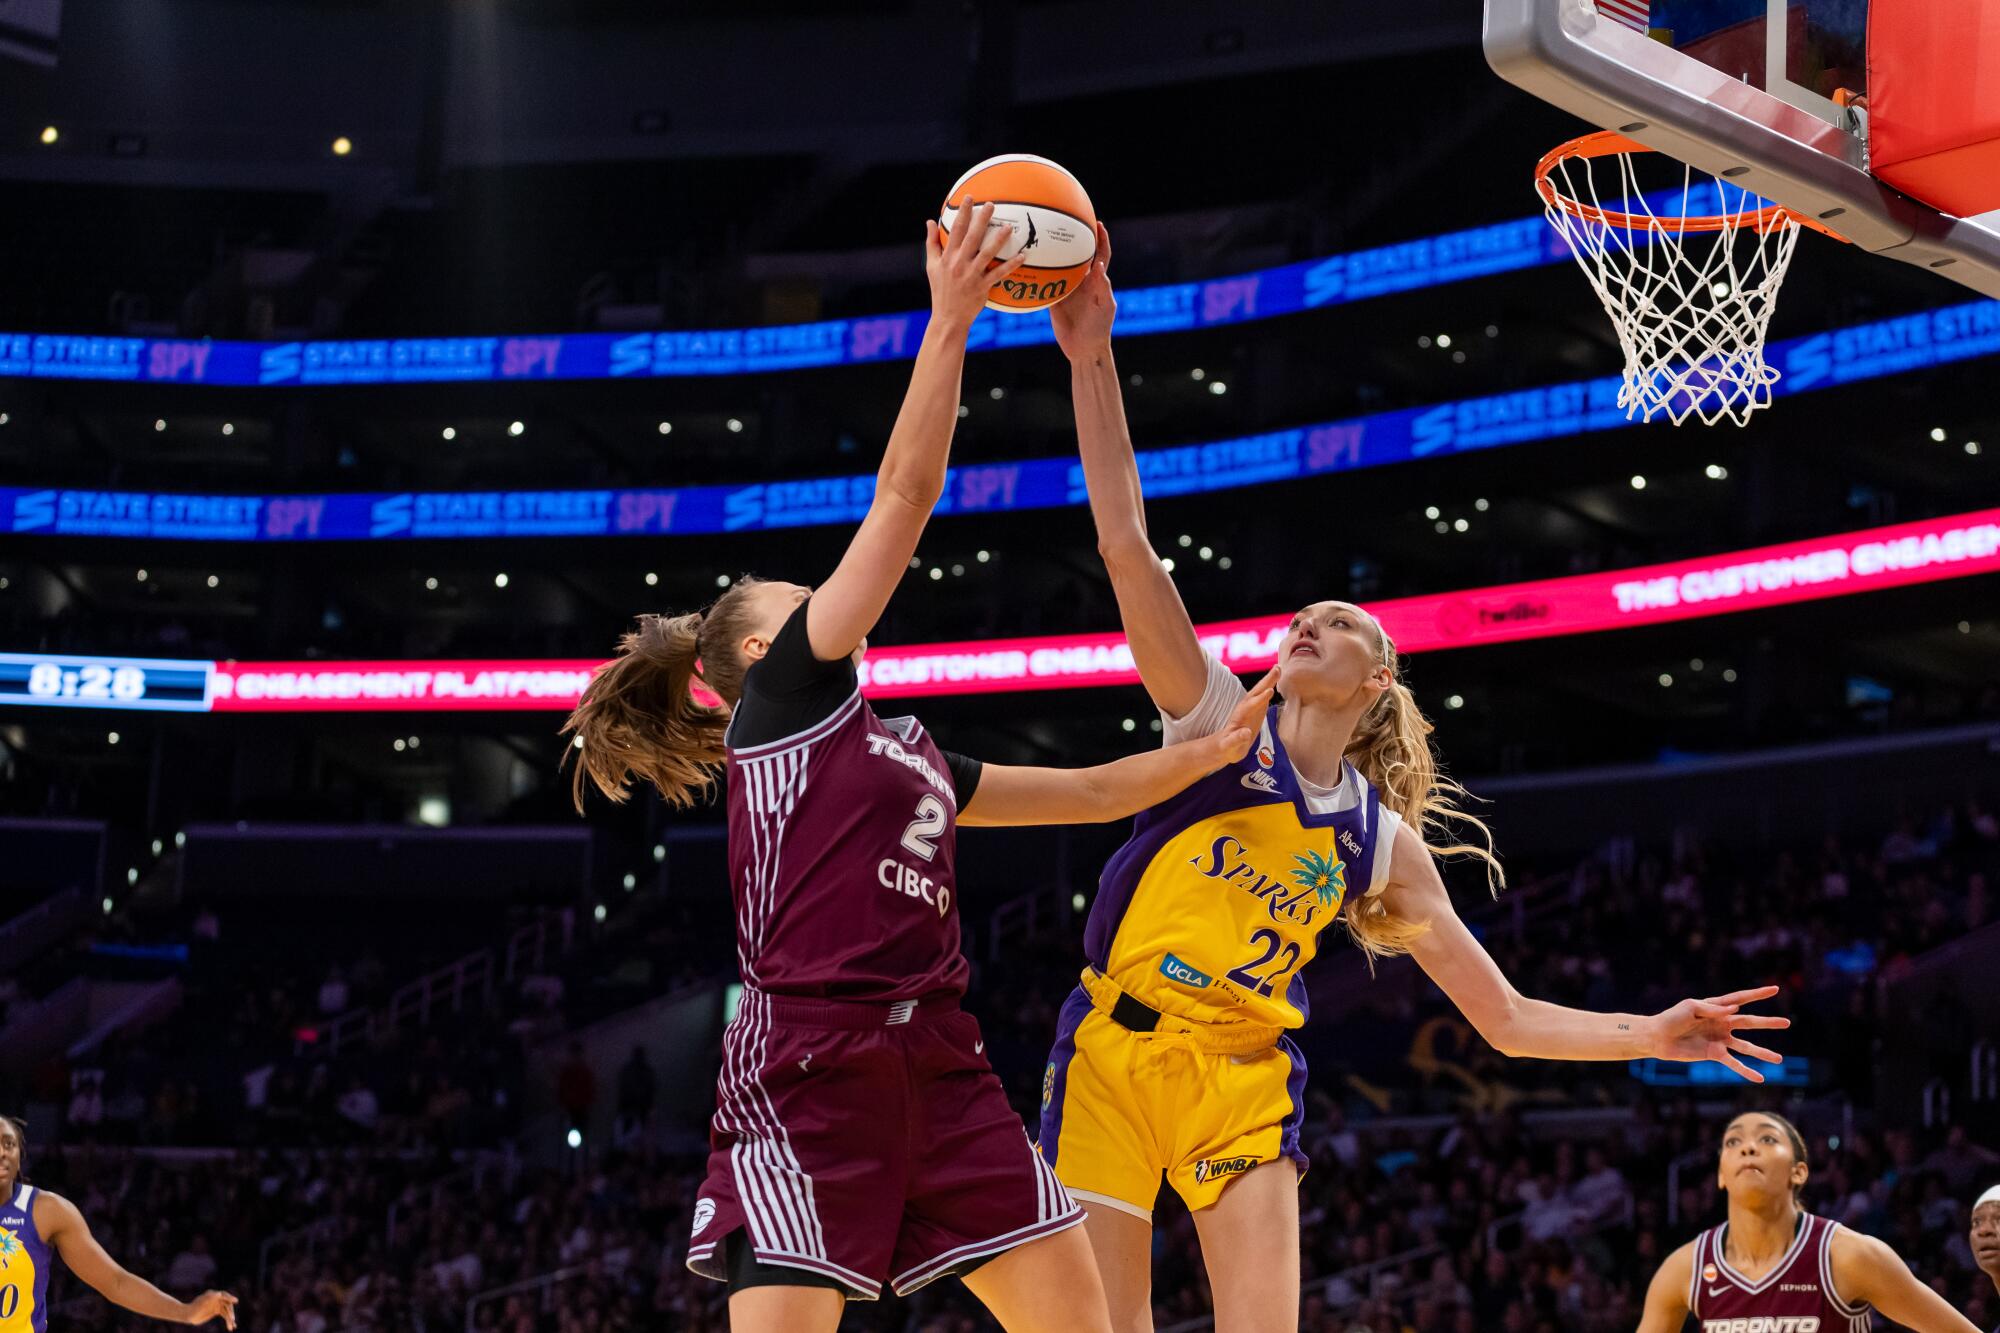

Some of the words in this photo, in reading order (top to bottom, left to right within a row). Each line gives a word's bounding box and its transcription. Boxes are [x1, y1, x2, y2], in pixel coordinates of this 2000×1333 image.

[1347, 240, 1430, 279] STATE
[991, 279, 1067, 301] Wils
[1202, 275, 1261, 323] SPY
[655, 331, 742, 359] STATE
[745, 321, 848, 355] STREET
[850, 319, 907, 358] SPY
[1833, 313, 1930, 361] STATE
[32, 335, 145, 362] STREET
[149, 342, 210, 380] SPY
[304, 342, 388, 367] STATE
[391, 338, 498, 366] STREET
[502, 338, 561, 376] SPY
[1201, 430, 1302, 472] STREET
[1307, 424, 1364, 470] SPY
[766, 479, 848, 510] STATE
[960, 467, 1018, 509] SPY
[60, 490, 148, 519] STATE
[152, 495, 263, 523] STREET
[266, 499, 324, 536] SPY
[415, 493, 502, 521] STATE
[505, 491, 613, 520] STREET
[617, 493, 678, 533] SPY
[1613, 575, 1679, 612] THE
[1680, 548, 1848, 603] CUSTOMER
[29, 662, 145, 698] 8:28
[236, 672, 432, 698] ENGAGEMENT
[872, 651, 1027, 685] CUSTOMER
[1250, 768, 1277, 787] NIKE
[901, 793, 947, 862] 2
[1338, 829, 1362, 858] Albert
[878, 858, 935, 906] CIBC
[1166, 960, 1203, 986] UCLA
[1225, 928, 1301, 999] 22
[1211, 1158, 1258, 1177] WNBA
[1, 1216, 24, 1226] Albert
[1780, 1284, 1817, 1292] SEPHORA
[1703, 1316, 1821, 1333] TORONTO
